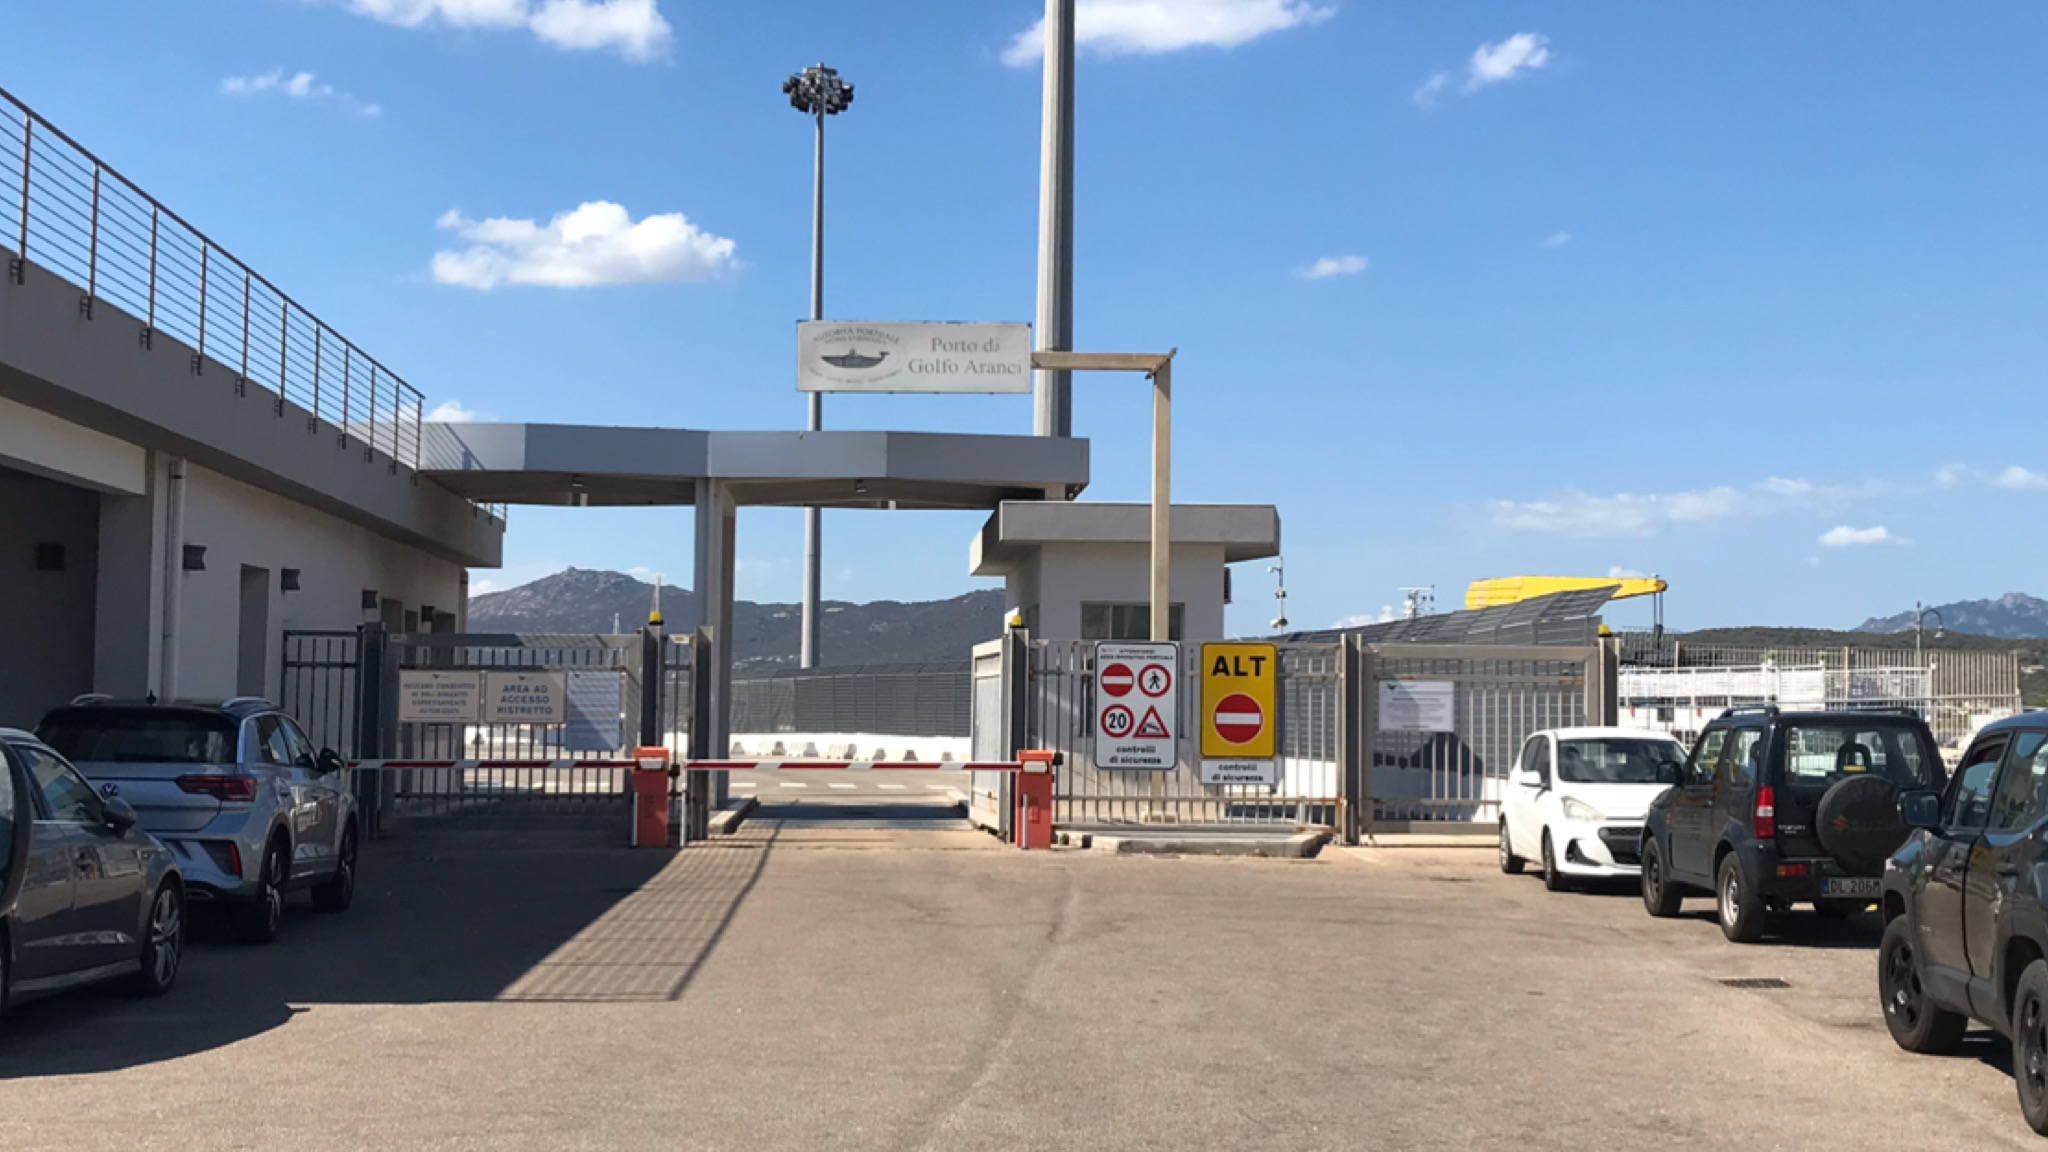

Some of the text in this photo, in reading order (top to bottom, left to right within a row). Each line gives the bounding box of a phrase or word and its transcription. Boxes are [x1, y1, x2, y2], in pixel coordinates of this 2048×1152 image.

[931, 337, 1000, 353] Porto di
[908, 358, 1022, 375] Golfo Aranci
[1211, 655, 1267, 677] ALT
[502, 685, 548, 693] AREA AD
[500, 695, 550, 704] ACCESSO
[496, 706, 553, 714] RISTRETTO
[1108, 713, 1127, 729] 20
